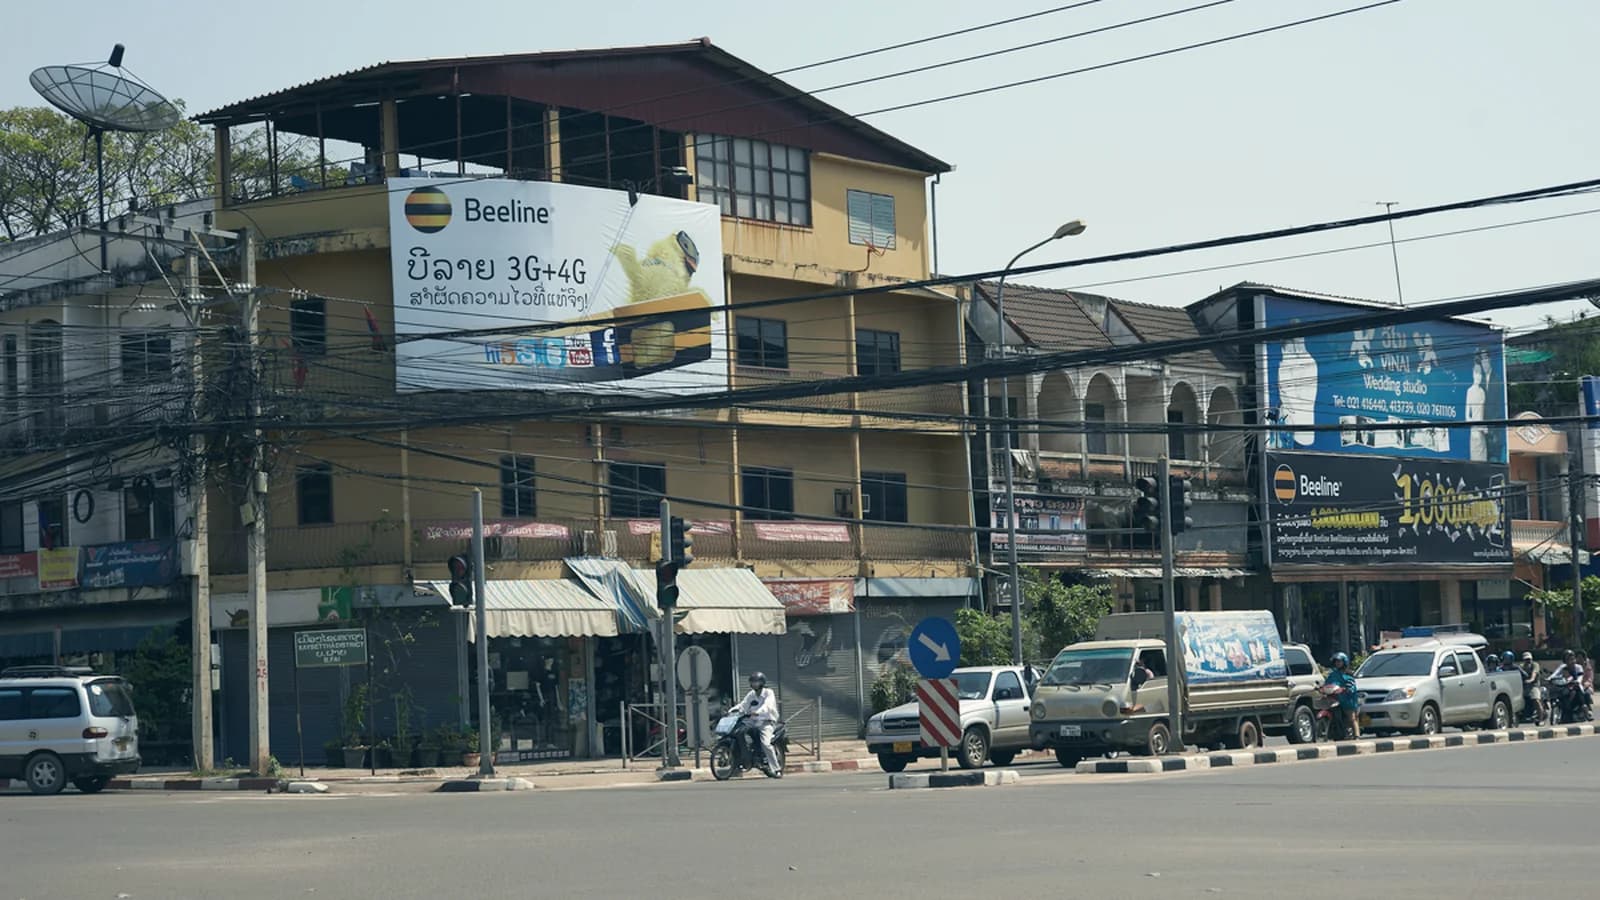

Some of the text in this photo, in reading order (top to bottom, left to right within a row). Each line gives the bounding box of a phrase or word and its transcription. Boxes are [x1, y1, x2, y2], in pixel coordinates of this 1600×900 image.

[464, 197, 549, 224] Beeline
[507, 255, 587, 284] 3G+4G
[1380, 353, 1411, 373] VINAI
[1363, 373, 1428, 396] Wedding studio
[1300, 475, 1340, 497] Beeline
